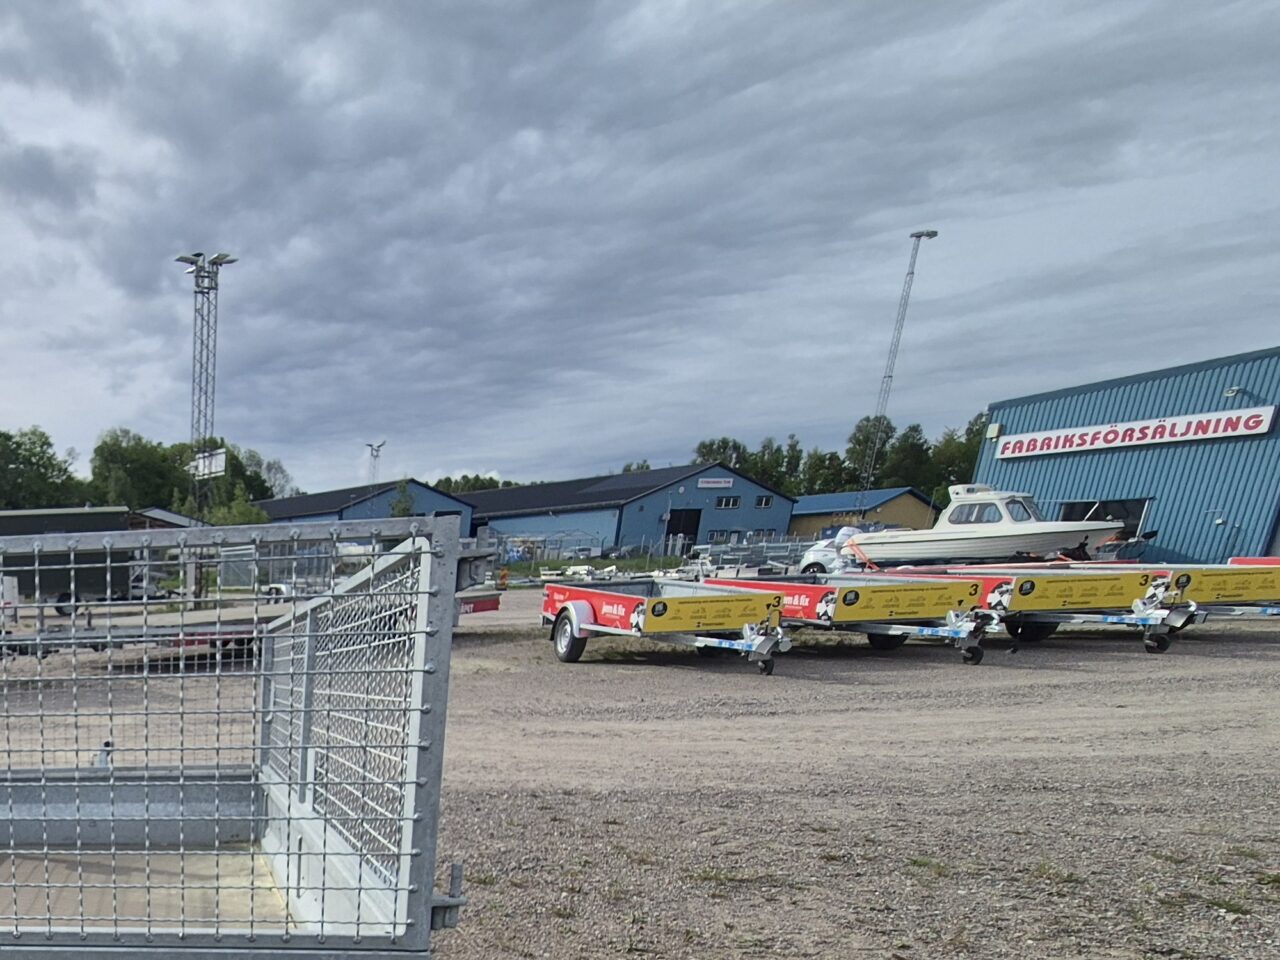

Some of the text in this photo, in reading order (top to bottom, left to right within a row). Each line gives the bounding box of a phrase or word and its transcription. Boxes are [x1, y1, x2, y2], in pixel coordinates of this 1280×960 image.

[1000, 413, 1264, 456] FABRIKSFÖRSÄLJNING
[1139, 574, 1150, 586] 3
[968, 583, 979, 597] 3
[772, 595, 782, 608] 3
